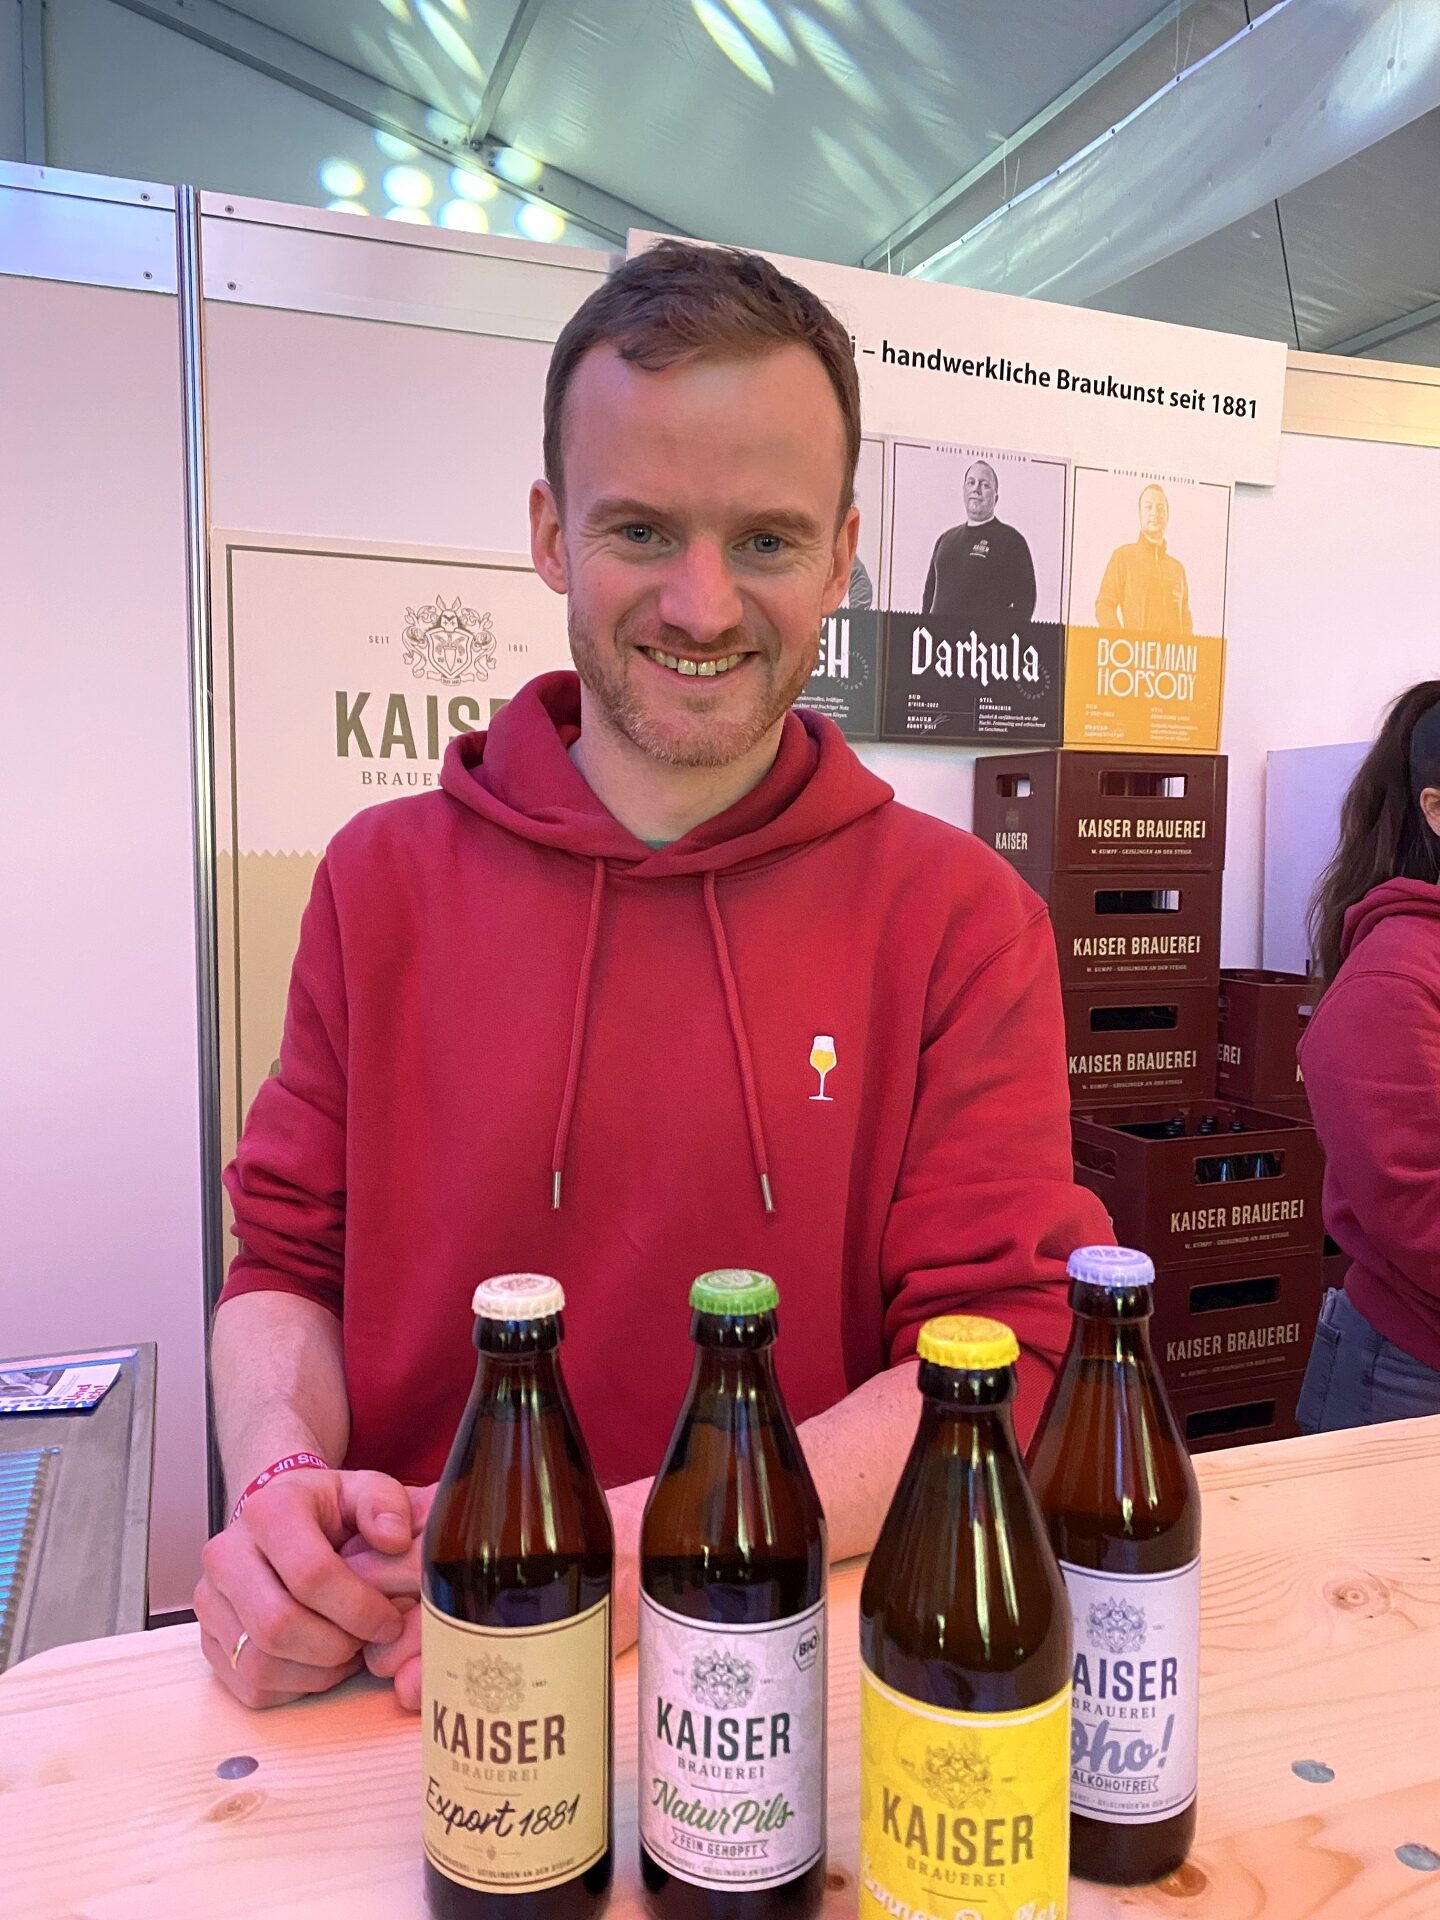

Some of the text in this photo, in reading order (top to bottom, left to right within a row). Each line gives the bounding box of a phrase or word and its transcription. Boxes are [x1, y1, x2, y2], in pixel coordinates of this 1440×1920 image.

[882, 340, 1051, 387] handwerkliche
[1057, 369, 1165, 405] Braukunst
[1170, 389, 1206, 412] seit
[1212, 394, 1257, 419] 1881
[368, 635, 529, 654] SEIT 1881
[911, 626, 1039, 687] Darkula
[1097, 638, 1198, 672] BOHEMIAN
[1096, 668, 1197, 701] HOPSODY
[335, 690, 512, 760] KAIS
[361, 771, 441, 787] BRAUE
[995, 832, 1028, 850] KAISER
[1078, 819, 1206, 839] KAISER BRAUEREI
[1073, 935, 1200, 956] KAISER BRAUEREI
[1069, 1050, 1197, 1074] KAISER BRAUEREI
[1170, 1199, 1304, 1233] KAISER BRAUEREI
[1166, 1322, 1300, 1362] KAISER BRAUEREI
[273, 1457, 295, 1473] UP
[799, 1634, 817, 1657] BIO
[1071, 1697, 1157, 1720] BRAUEREI
[432, 1699, 566, 1765] KAISER
[657, 1696, 791, 1762] KAISER
[451, 1758, 539, 1783] BRAUEREI
[677, 1756, 765, 1780] BRAUEREI
[425, 1775, 581, 1838] Export 1881
[881, 1786, 1034, 1868] KAISER
[679, 1834, 704, 1851] FEIN
[707, 1843, 758, 1857] GEHOPFT
[906, 1855, 1006, 1887] BRAUEREI
